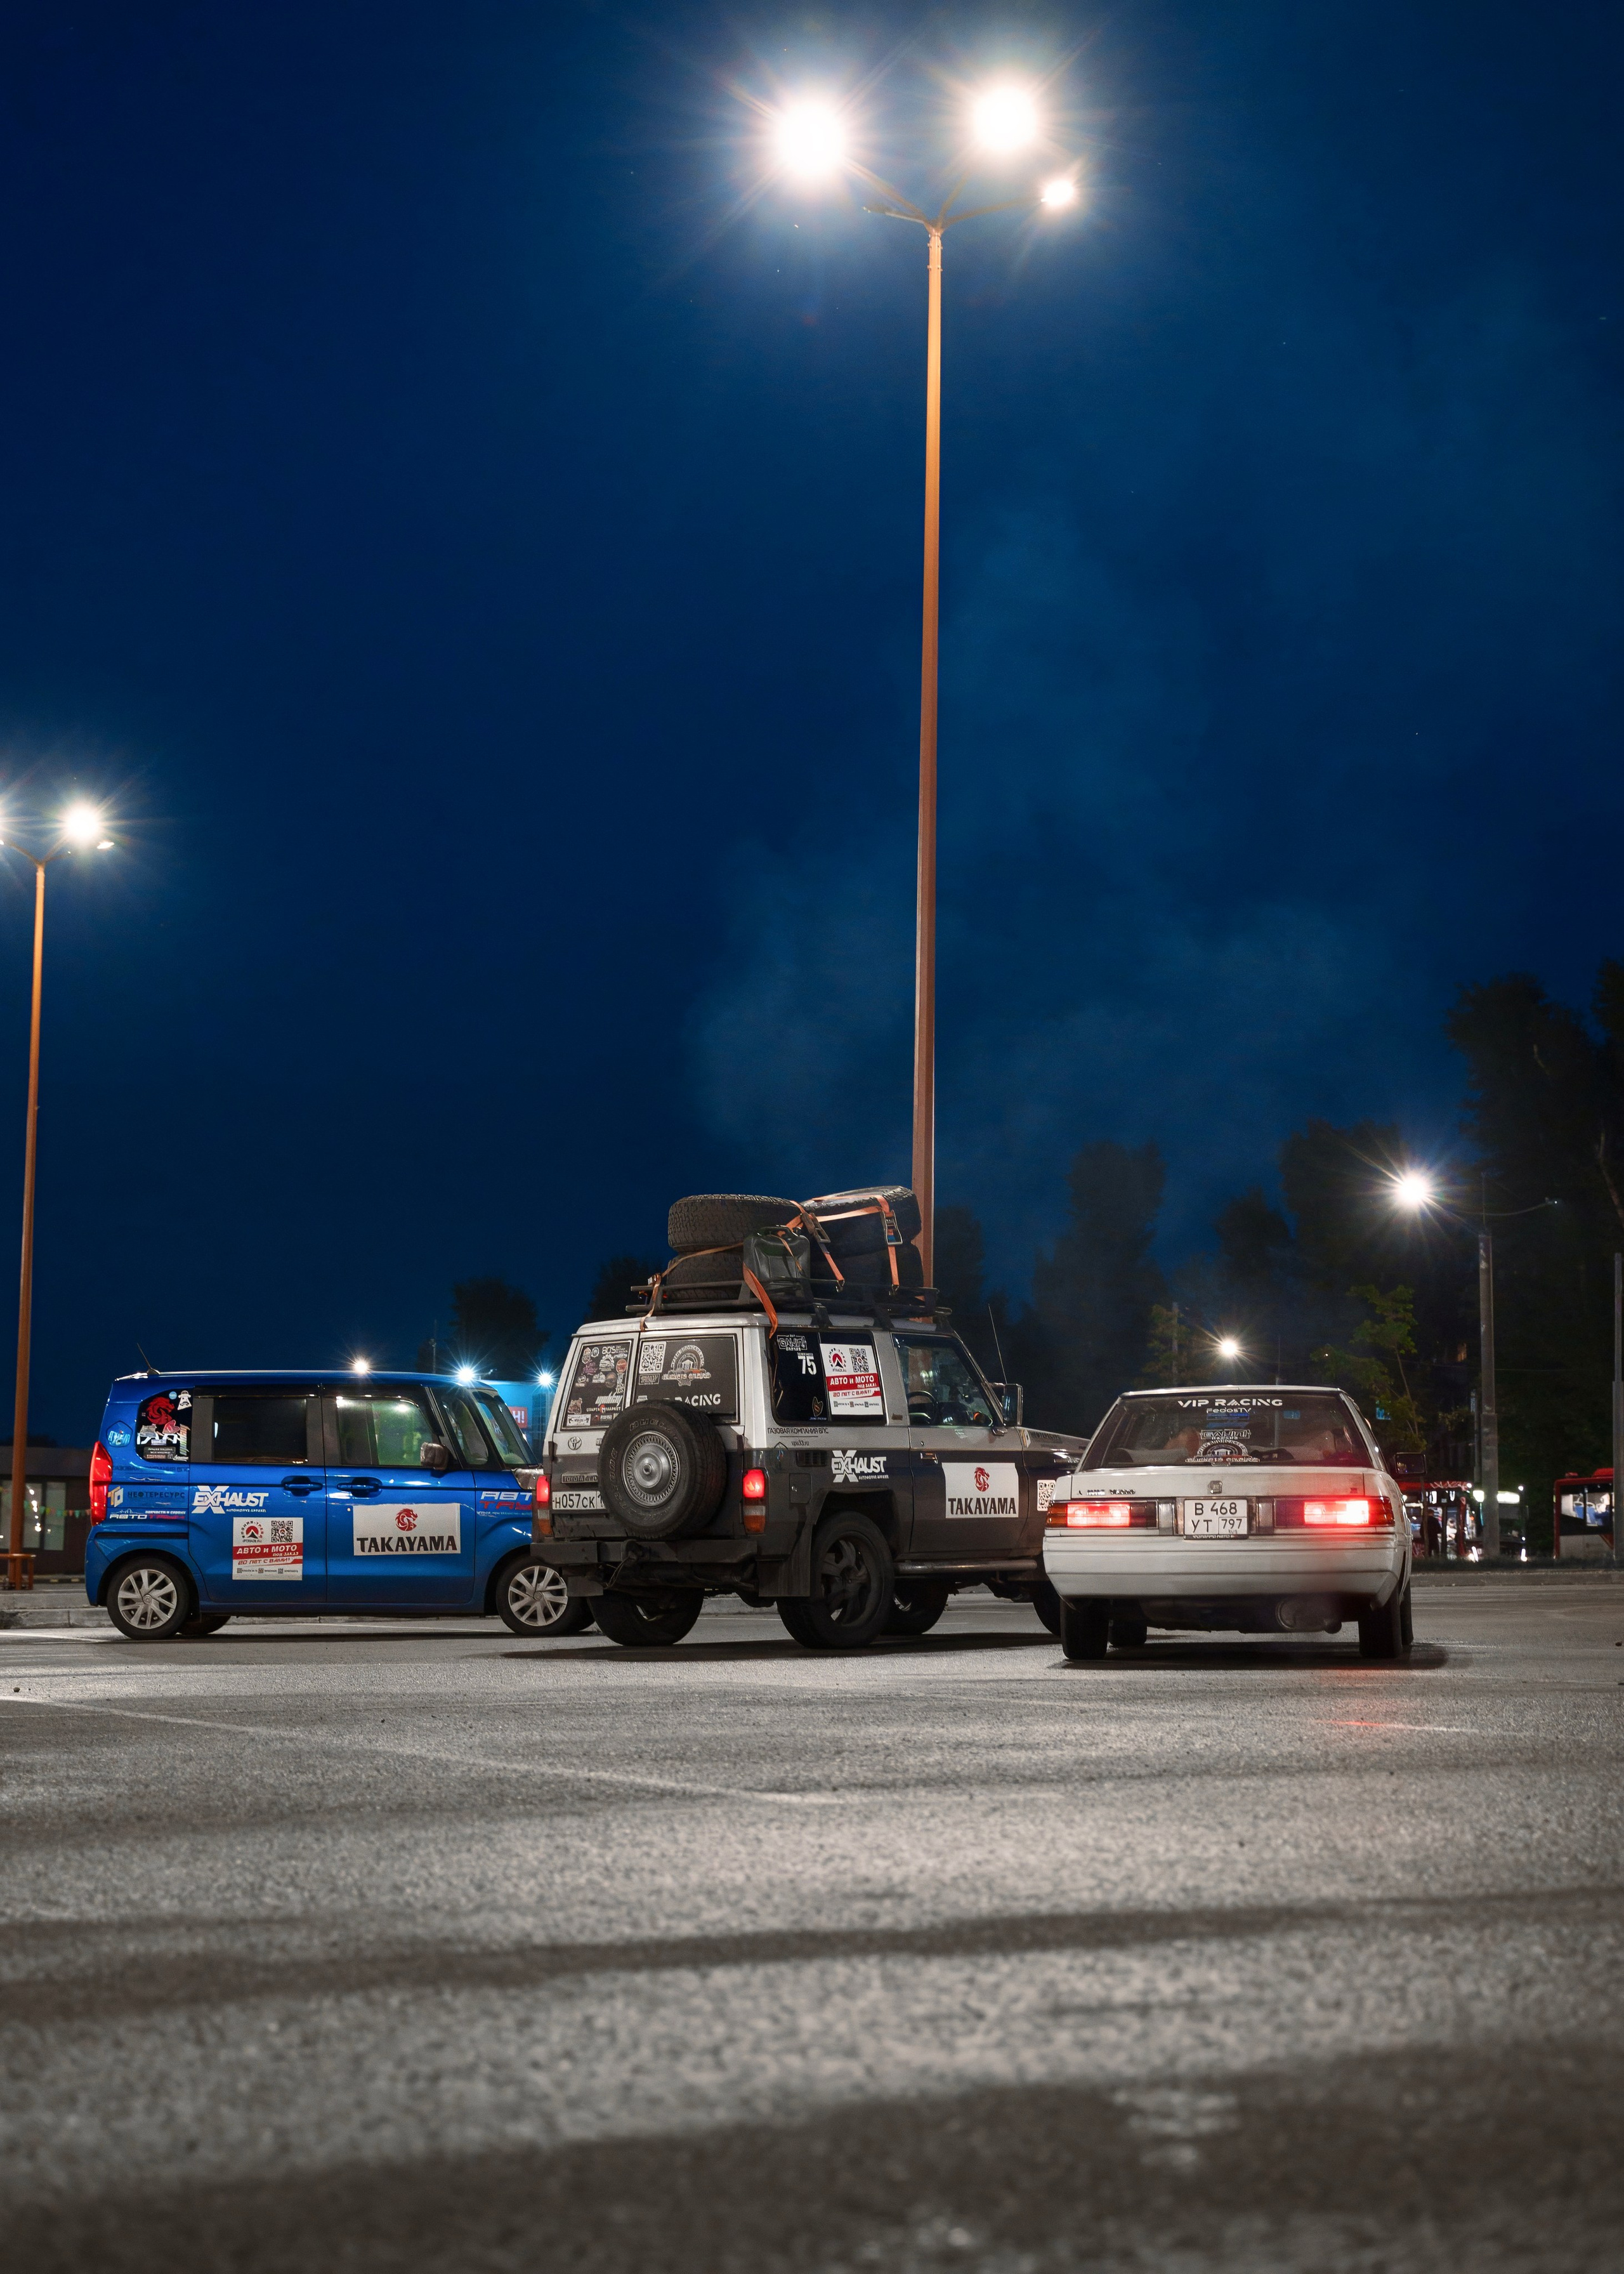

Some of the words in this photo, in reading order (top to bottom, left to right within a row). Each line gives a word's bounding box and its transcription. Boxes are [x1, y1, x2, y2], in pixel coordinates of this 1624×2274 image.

[797, 1355, 817, 1375] 75
[830, 1377, 848, 1386] АВТО
[855, 1375, 874, 1384] МОТО
[1178, 1400, 1209, 1408] VIP
[1215, 1398, 1283, 1407] RACING
[832, 1450, 887, 1483] EXHAUST
[192, 1485, 269, 1514] EXHAUST
[554, 1493, 595, 1509] Н057СК
[948, 1497, 1017, 1515] TAKAYAMA
[1195, 1502, 1204, 1515] В
[1210, 1502, 1237, 1515] 468
[1221, 1518, 1242, 1530] 797
[272, 1544, 297, 1553] МОТО
[357, 1535, 457, 1553] TAKAYAMA
